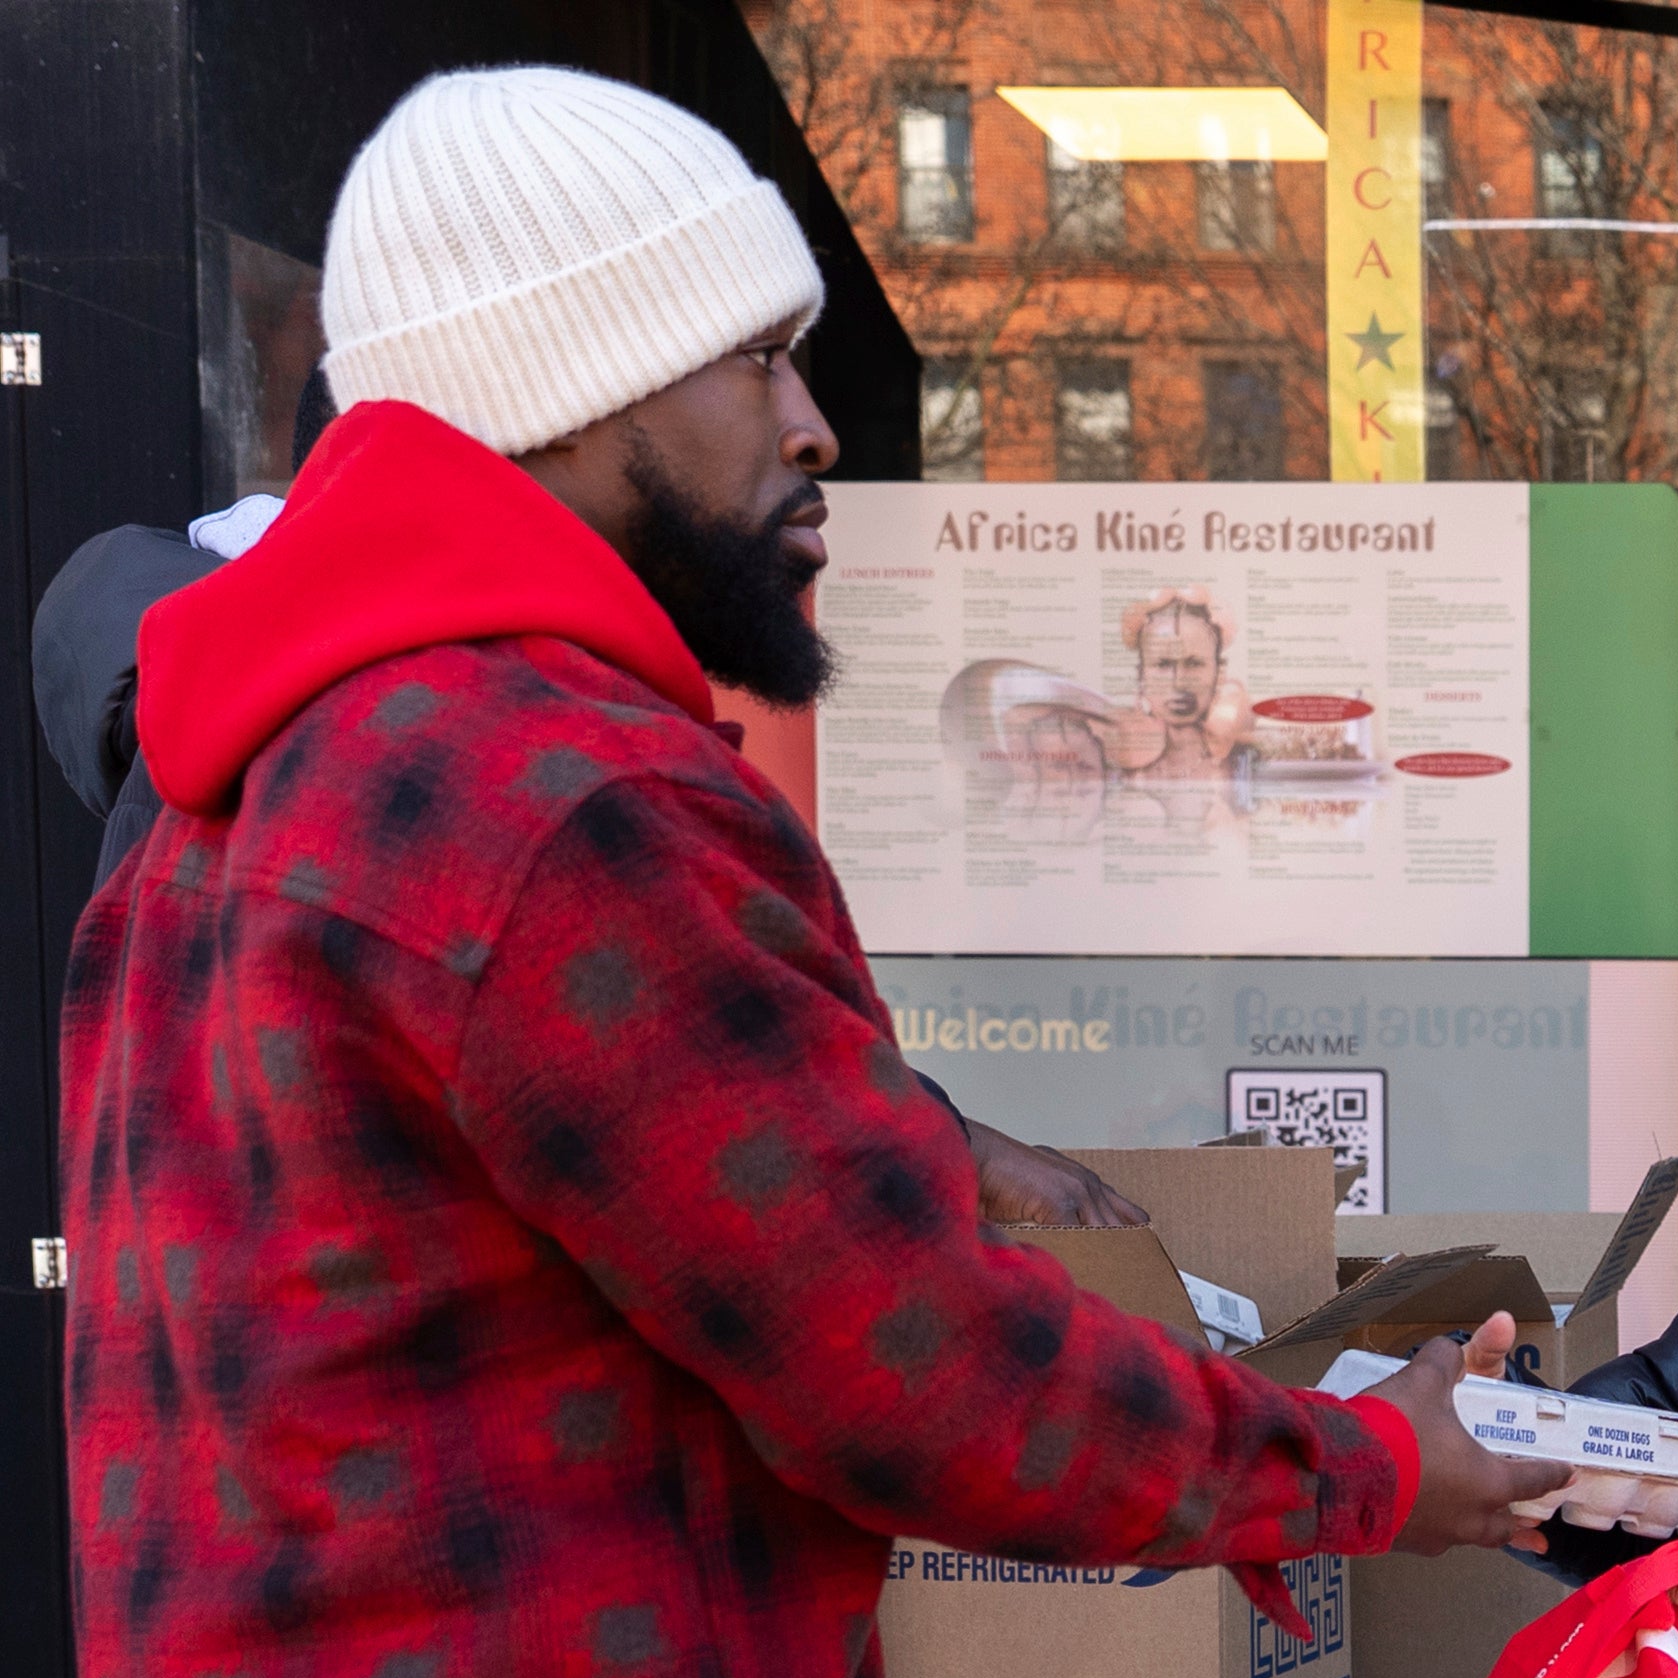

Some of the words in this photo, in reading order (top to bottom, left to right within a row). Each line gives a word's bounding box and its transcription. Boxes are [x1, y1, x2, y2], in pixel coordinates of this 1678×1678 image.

[936, 510, 1078, 552] Africa
[1096, 507, 1186, 552] Kiné
[1204, 511, 1437, 552] Restaurant
[899, 1006, 1112, 1052] Welcome
[1250, 1033, 1314, 1056] SCAN
[1322, 1033, 1361, 1056] ME
[1496, 1408, 1517, 1424] KEEP
[1474, 1424, 1537, 1445] REFRIGERATED
[1587, 1425, 1605, 1439] ONE
[1605, 1427, 1631, 1443] DOZEN
[1631, 1431, 1652, 1446] EGGS
[1582, 1440, 1615, 1457] GRADE
[1615, 1444, 1624, 1458] A
[1625, 1446, 1655, 1463] LARGE
